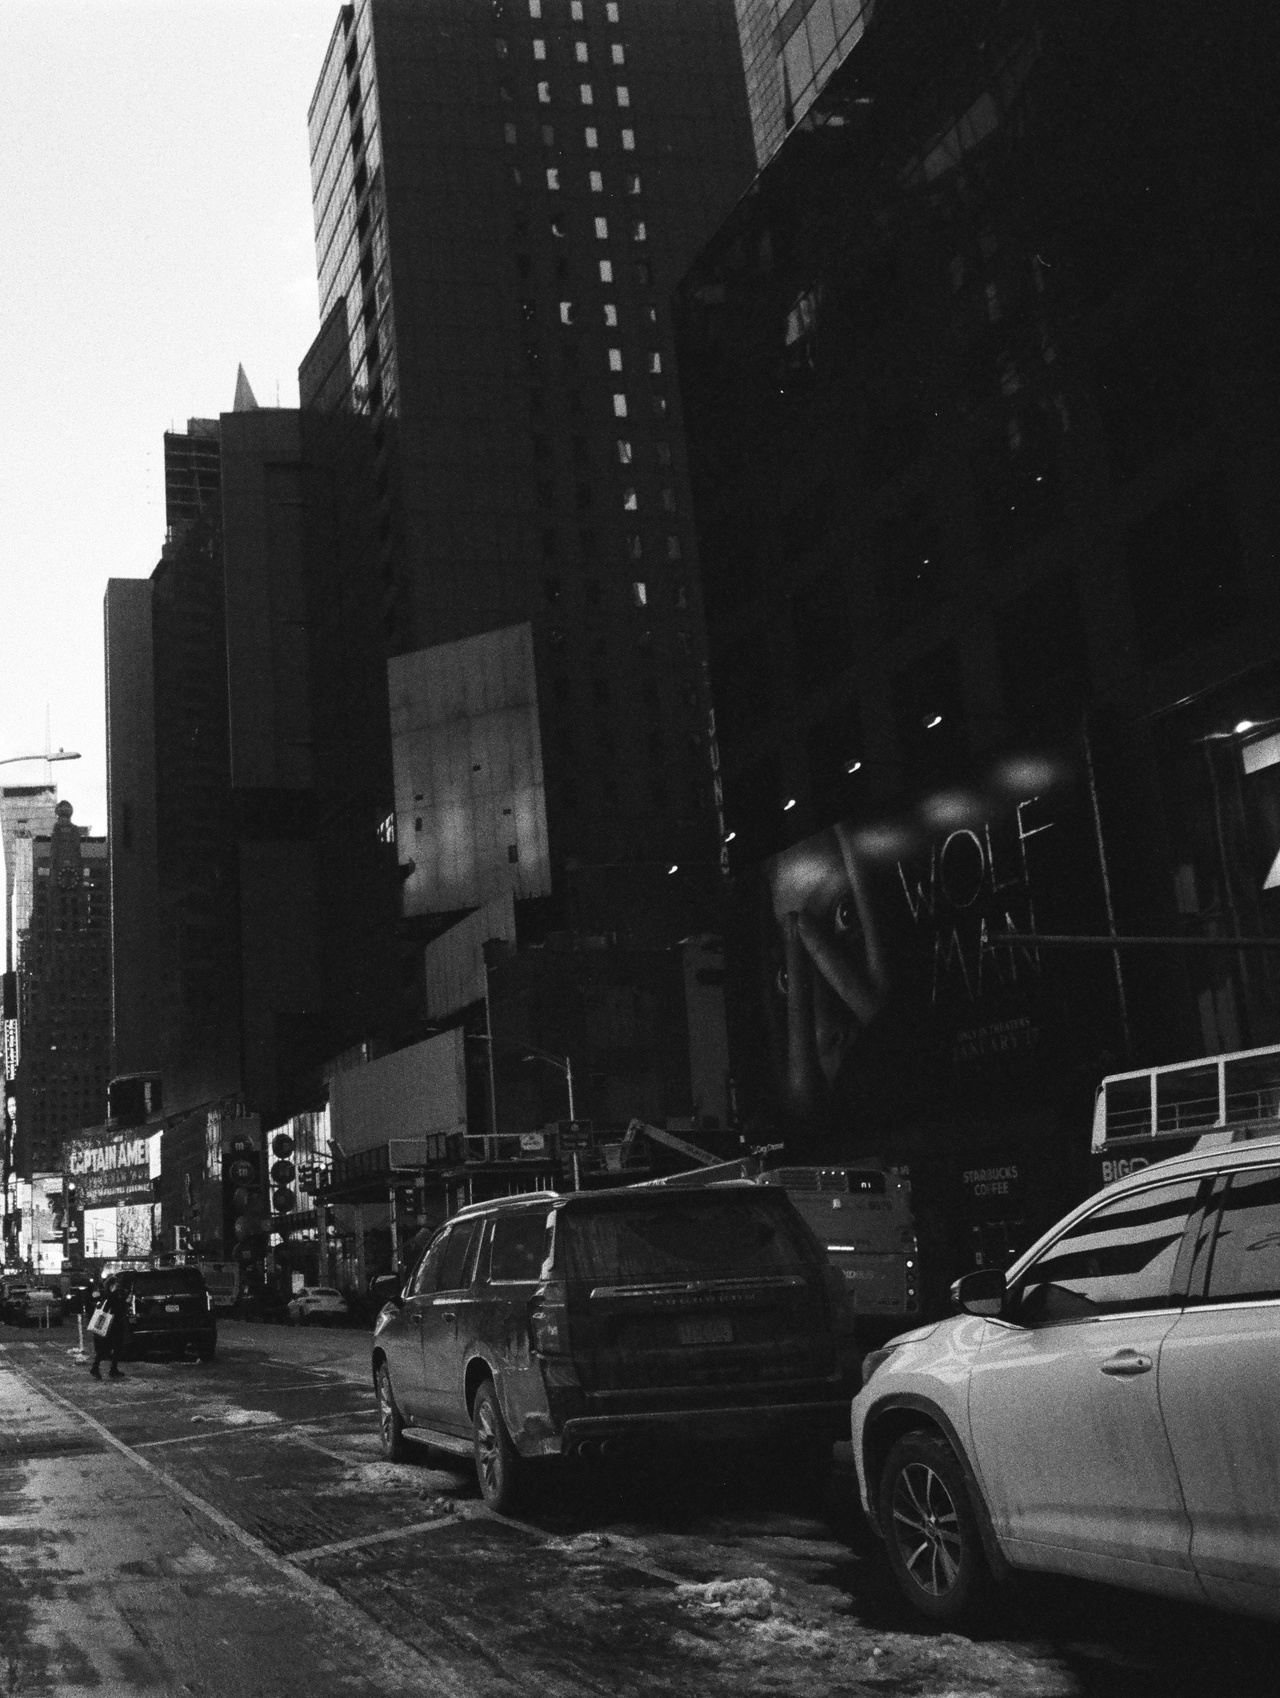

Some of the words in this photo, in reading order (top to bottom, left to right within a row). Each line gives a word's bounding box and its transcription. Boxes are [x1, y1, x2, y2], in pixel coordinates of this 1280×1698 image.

[897, 796, 1054, 924] WOLF
[931, 899, 1042, 1004] MAN
[963, 1165, 1019, 1184] STARBUCKS
[1102, 1158, 1129, 1182] BIG
[974, 1181, 1010, 1197] COFFEE
